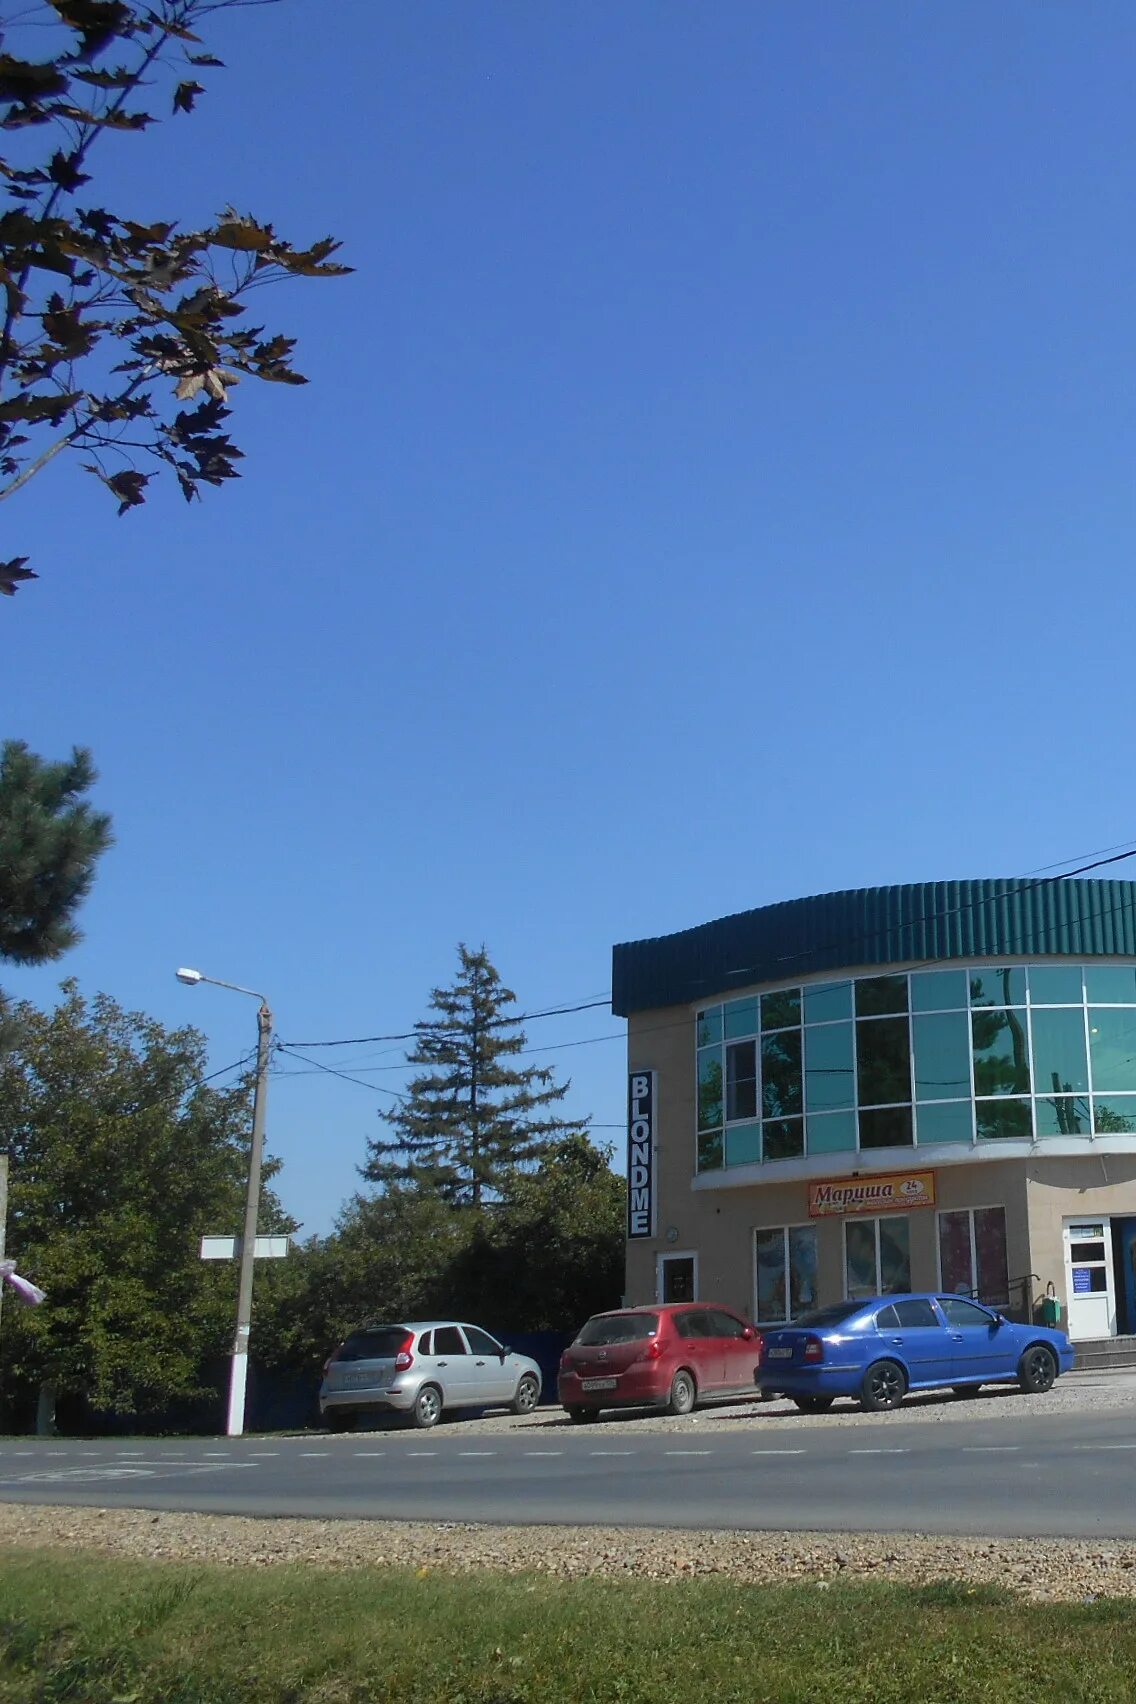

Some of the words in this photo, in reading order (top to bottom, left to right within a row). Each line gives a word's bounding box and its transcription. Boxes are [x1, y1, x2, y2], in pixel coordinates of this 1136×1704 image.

[631, 1076, 649, 1234] BLONDME
[815, 1184, 893, 1205] Мариша
[906, 1181, 917, 1190] 24
